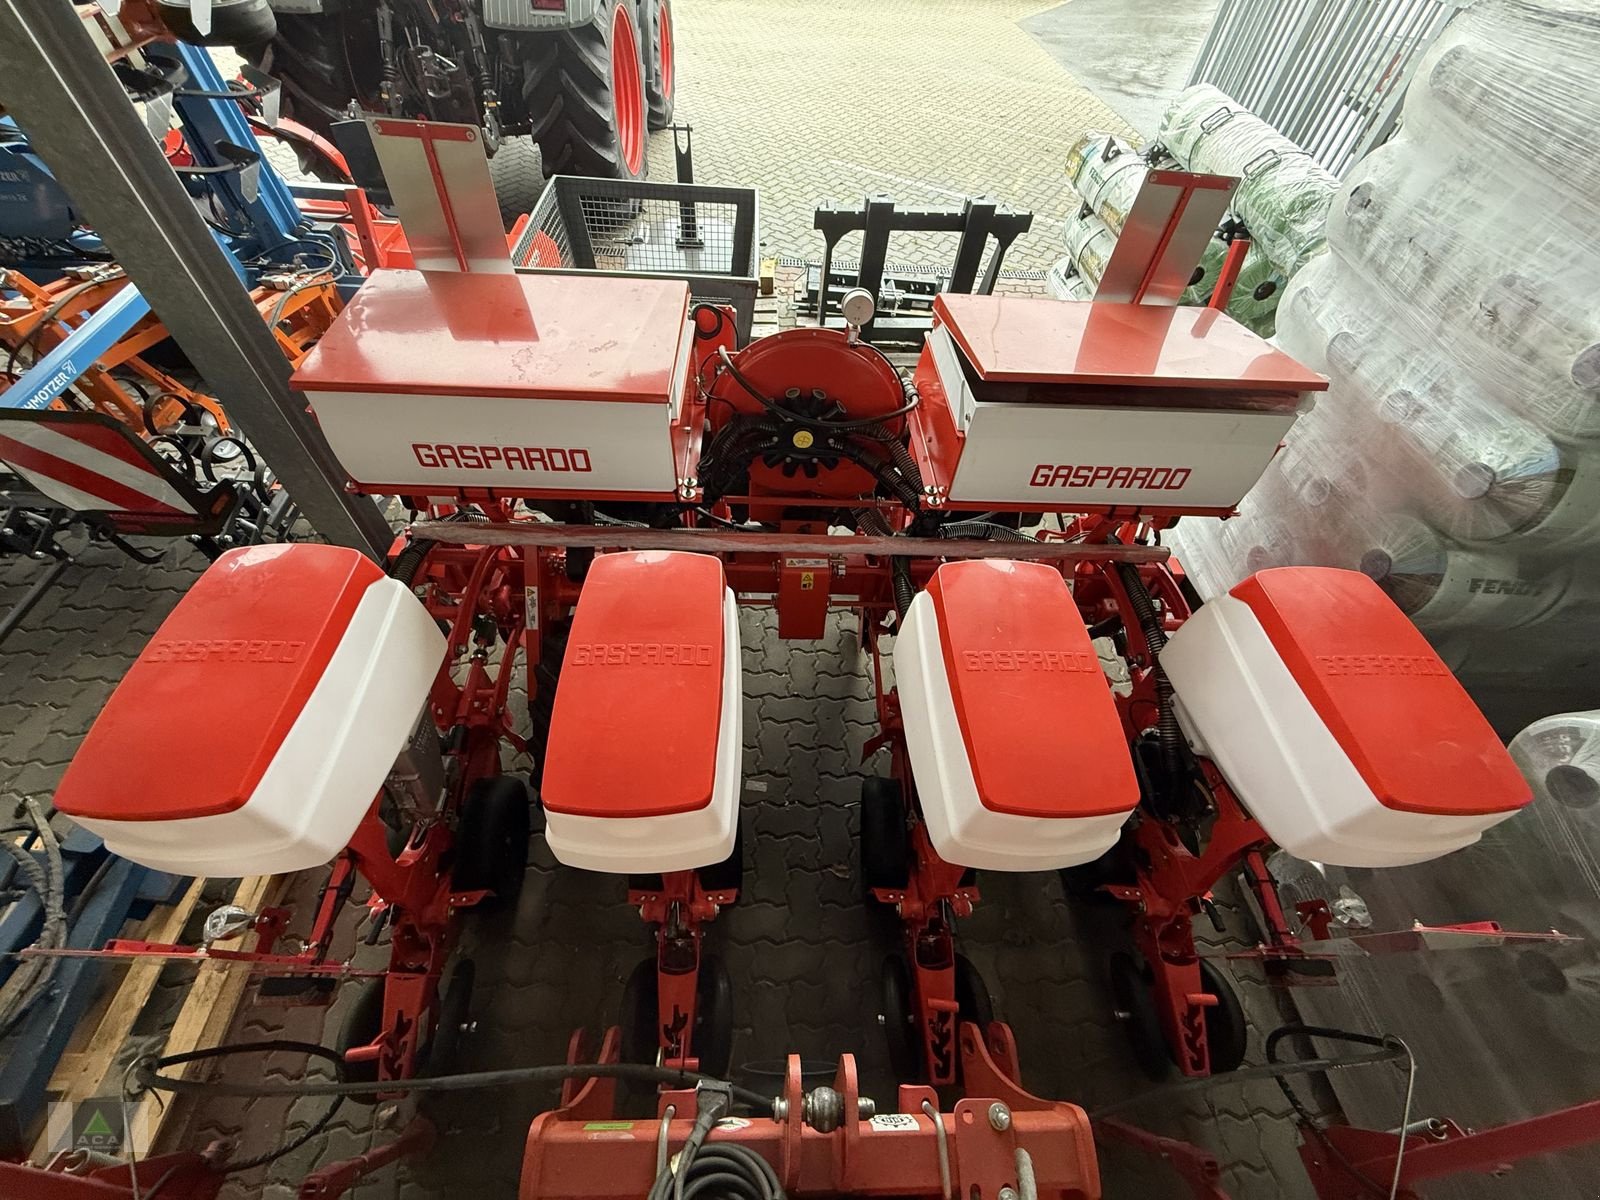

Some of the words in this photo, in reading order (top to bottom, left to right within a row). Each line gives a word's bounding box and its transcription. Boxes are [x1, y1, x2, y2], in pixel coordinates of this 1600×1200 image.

[22, 372, 70, 410] HMOTZER
[411, 443, 593, 472] GASPARDO
[1029, 464, 1192, 490] GASPARDO
[143, 639, 306, 664] GASPARDO
[571, 643, 713, 666] GASPARDO
[962, 650, 1097, 674] GASPARDO
[1316, 654, 1449, 677] GASPARDO
